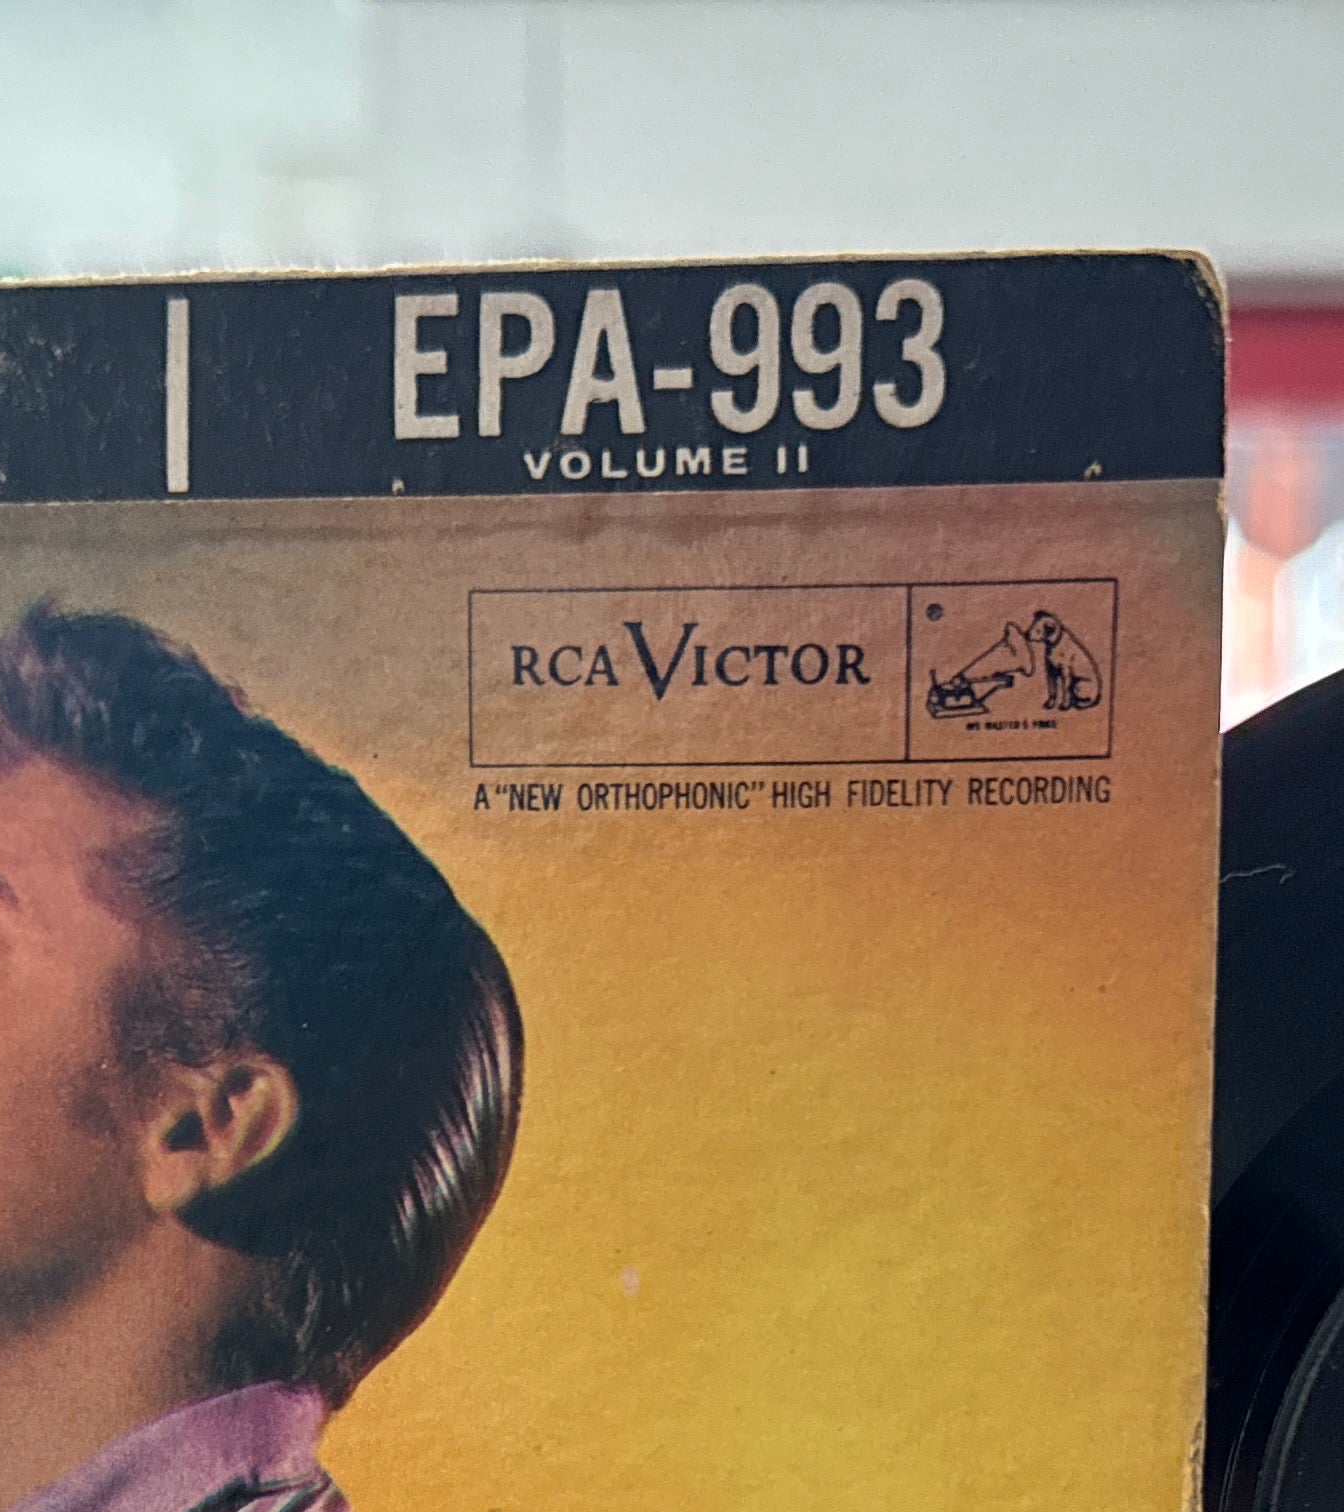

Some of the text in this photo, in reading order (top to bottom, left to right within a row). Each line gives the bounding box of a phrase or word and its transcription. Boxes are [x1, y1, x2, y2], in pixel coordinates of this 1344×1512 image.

[393, 278, 948, 440] EPA-993
[523, 444, 809, 480] VOLUME II
[511, 643, 620, 687] RCA
[473, 783, 491, 811] A
[771, 781, 831, 809] HIGH
[847, 779, 953, 808] FIDELITY
[967, 775, 1112, 806] RECORDING
